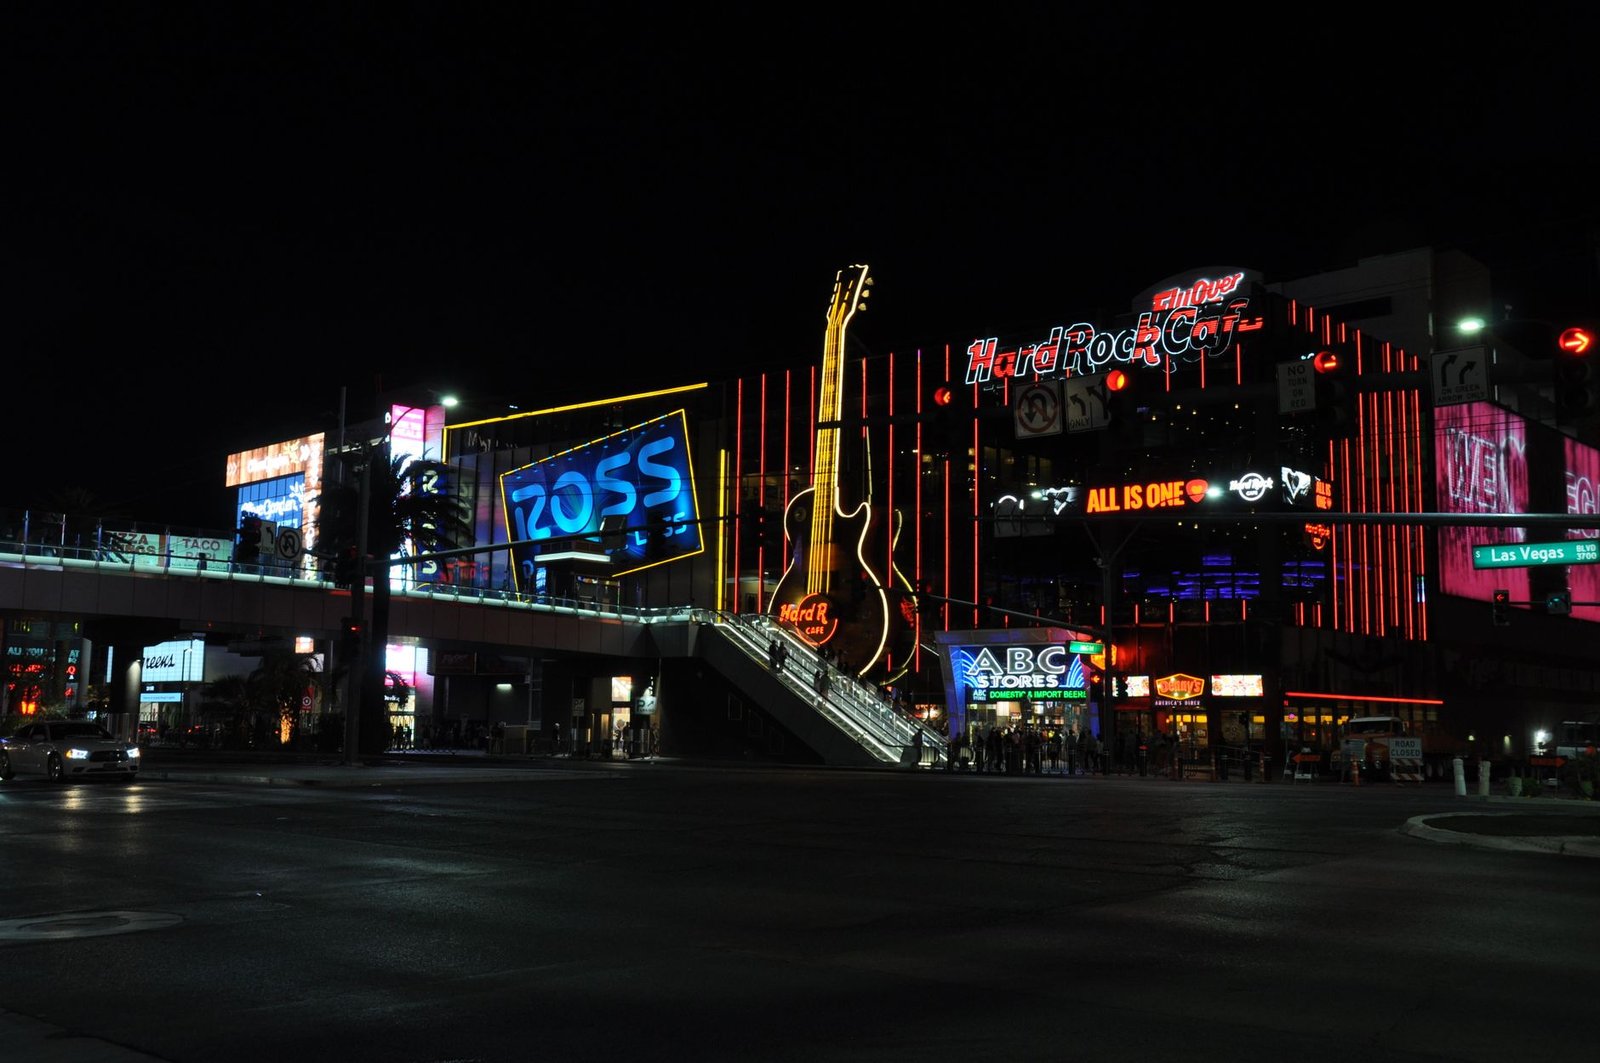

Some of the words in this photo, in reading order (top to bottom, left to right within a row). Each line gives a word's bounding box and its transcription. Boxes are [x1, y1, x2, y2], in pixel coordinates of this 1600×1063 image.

[965, 326, 1063, 385] Hard
[1063, 312, 1161, 378] Rock
[1288, 365, 1306, 376] NO
[1288, 377, 1307, 386] TURN
[1290, 399, 1306, 407] RED
[1069, 417, 1089, 428] ONLY
[512, 435, 682, 543] ROSS
[1251, 477, 1274, 491] Rock
[1087, 483, 1120, 512] ALL
[1124, 480, 1142, 509] IS
[1146, 481, 1185, 507] ONE
[182, 538, 220, 551] TACO
[1576, 544, 1597, 552] BLVD
[1475, 550, 1481, 558] S
[1491, 548, 1517, 562] Las
[1519, 546, 1565, 563] Vegas
[1576, 552, 1598, 560] 3700
[779, 603, 816, 627] Hard
[805, 626, 824, 635] CAFE
[967, 646, 1066, 676] ABC
[976, 673, 1060, 688] STORES
[1161, 679, 1201, 693] Denny's
[989, 690, 1027, 699] DOMESTIC
[1034, 690, 1062, 699] IMPORT
[1395, 740, 1415, 748] ROAD
[1391, 748, 1421, 757] CLOSED
